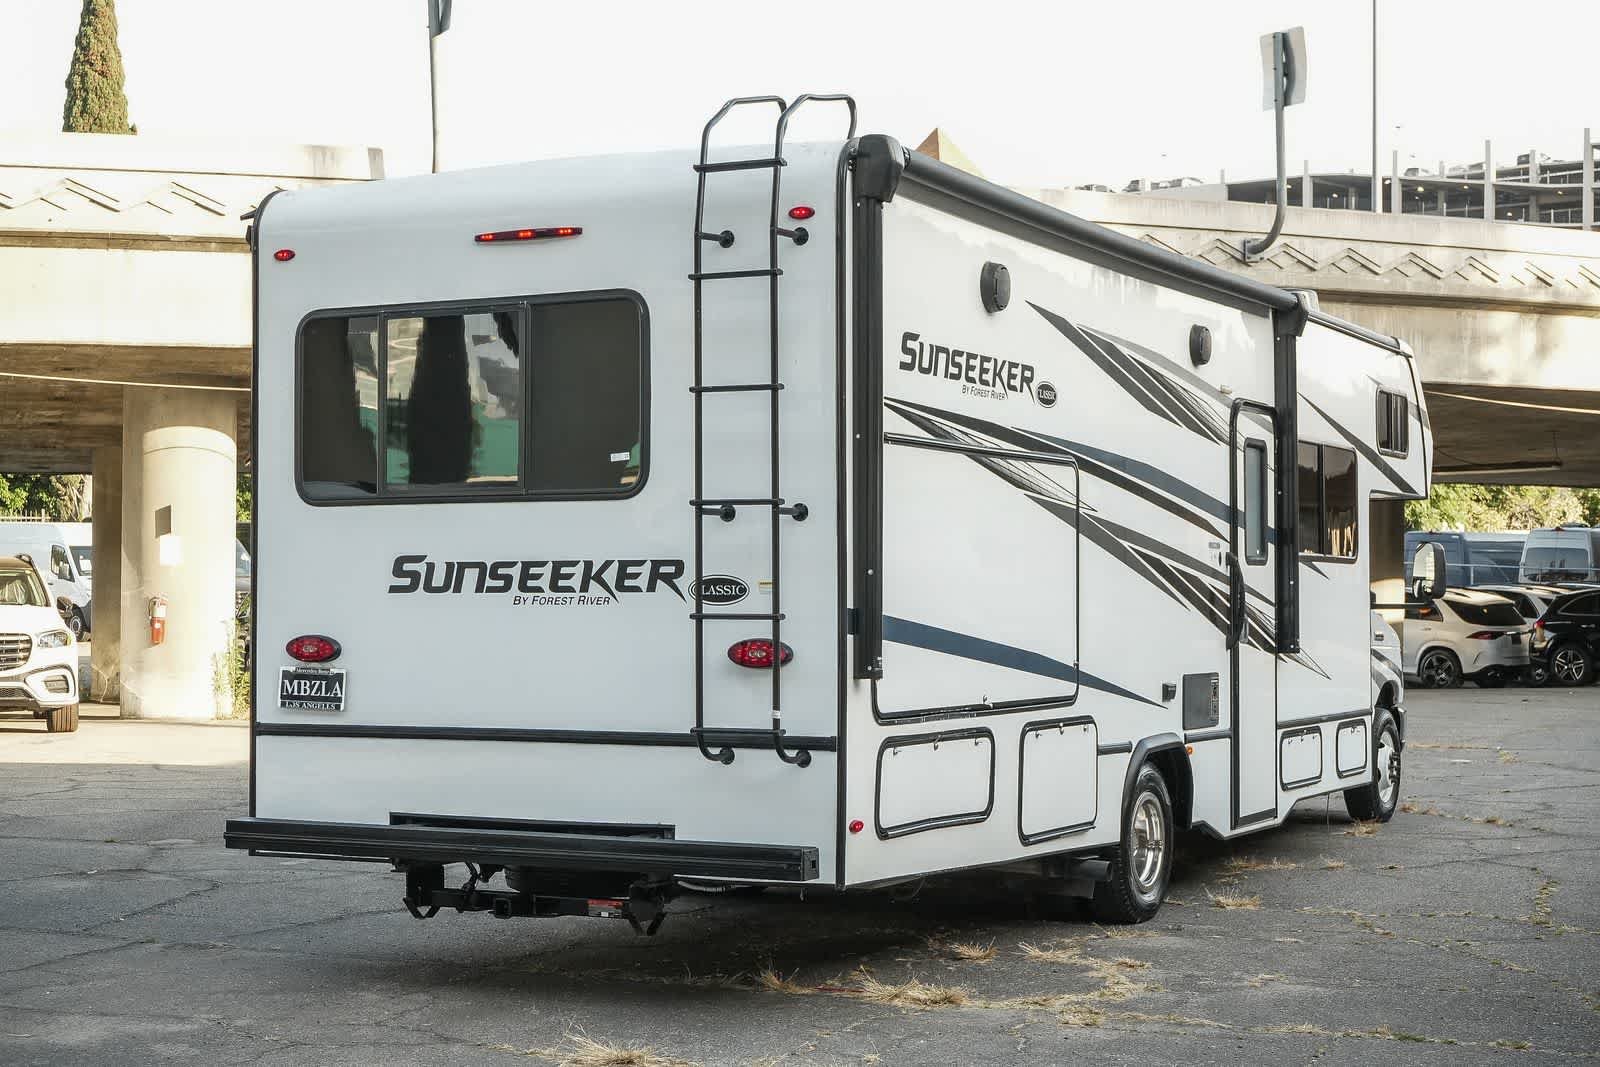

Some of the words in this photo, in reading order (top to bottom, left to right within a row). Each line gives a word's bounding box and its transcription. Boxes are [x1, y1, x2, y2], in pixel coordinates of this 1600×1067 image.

[513, 595, 528, 606] BY
[531, 595, 575, 606] FOREST
[577, 595, 611, 606] RIVER
[283, 680, 342, 697] MBZLA
